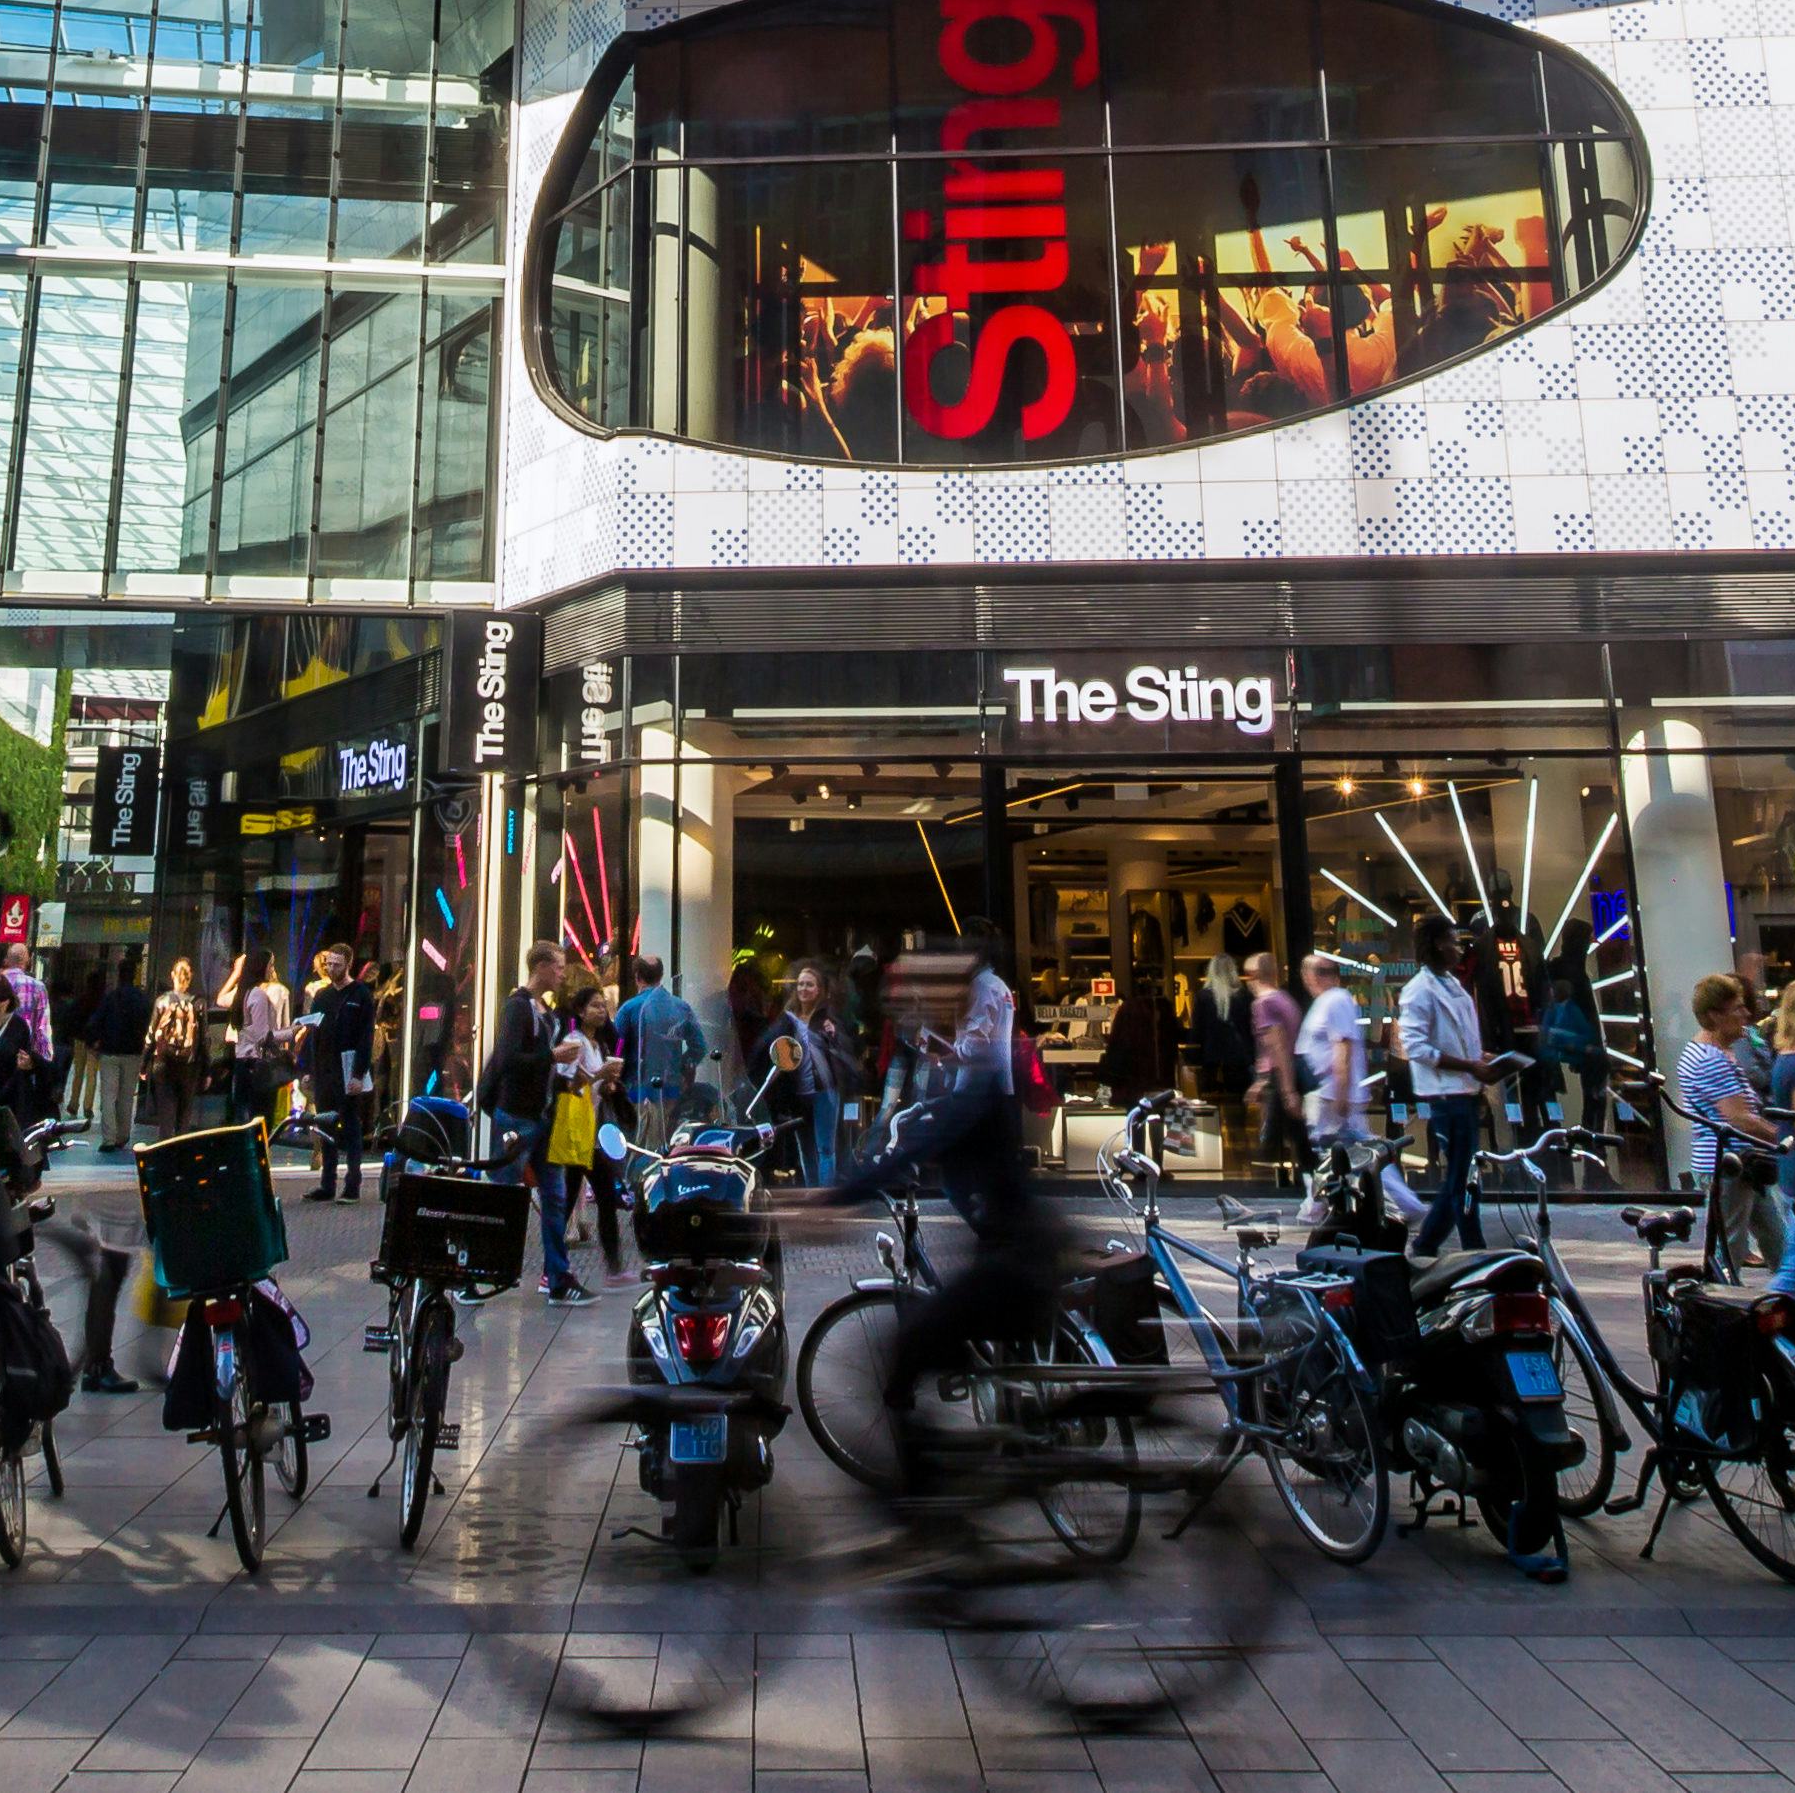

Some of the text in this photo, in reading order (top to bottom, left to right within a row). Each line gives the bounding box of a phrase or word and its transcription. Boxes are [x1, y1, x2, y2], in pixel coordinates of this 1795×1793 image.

[475, 620, 514, 764] The Sting
[1004, 665, 1275, 735] The Sting
[111, 752, 142, 848] The Sting
[339, 739, 407, 791] The Sting
